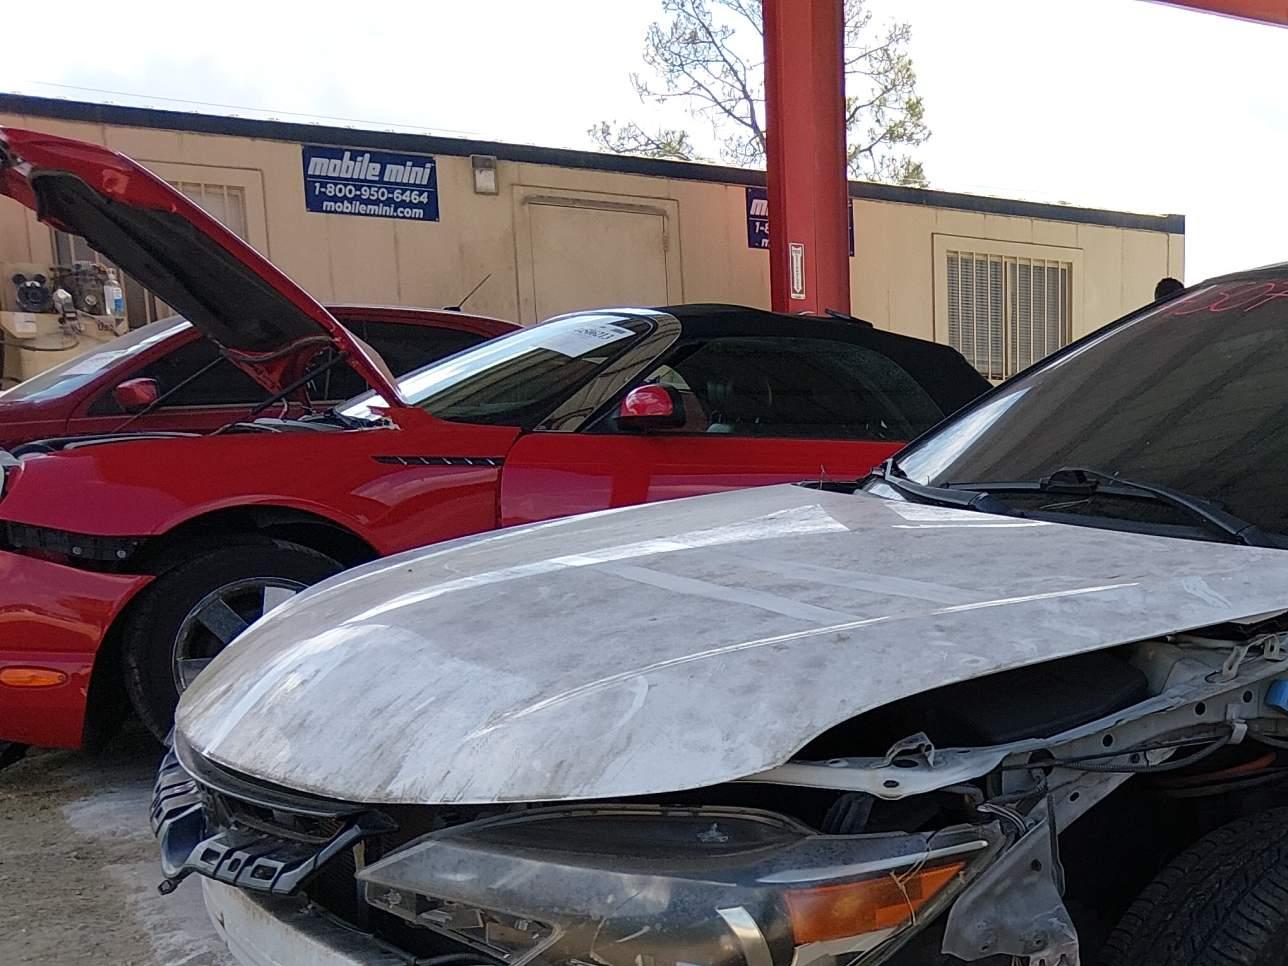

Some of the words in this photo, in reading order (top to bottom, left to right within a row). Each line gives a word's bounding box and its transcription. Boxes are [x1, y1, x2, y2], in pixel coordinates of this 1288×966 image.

[307, 151, 381, 181] mobile
[383, 161, 433, 185] mini
[314, 182, 429, 204] 1-800-950-6464
[322, 201, 424, 218] mobilemini.com
